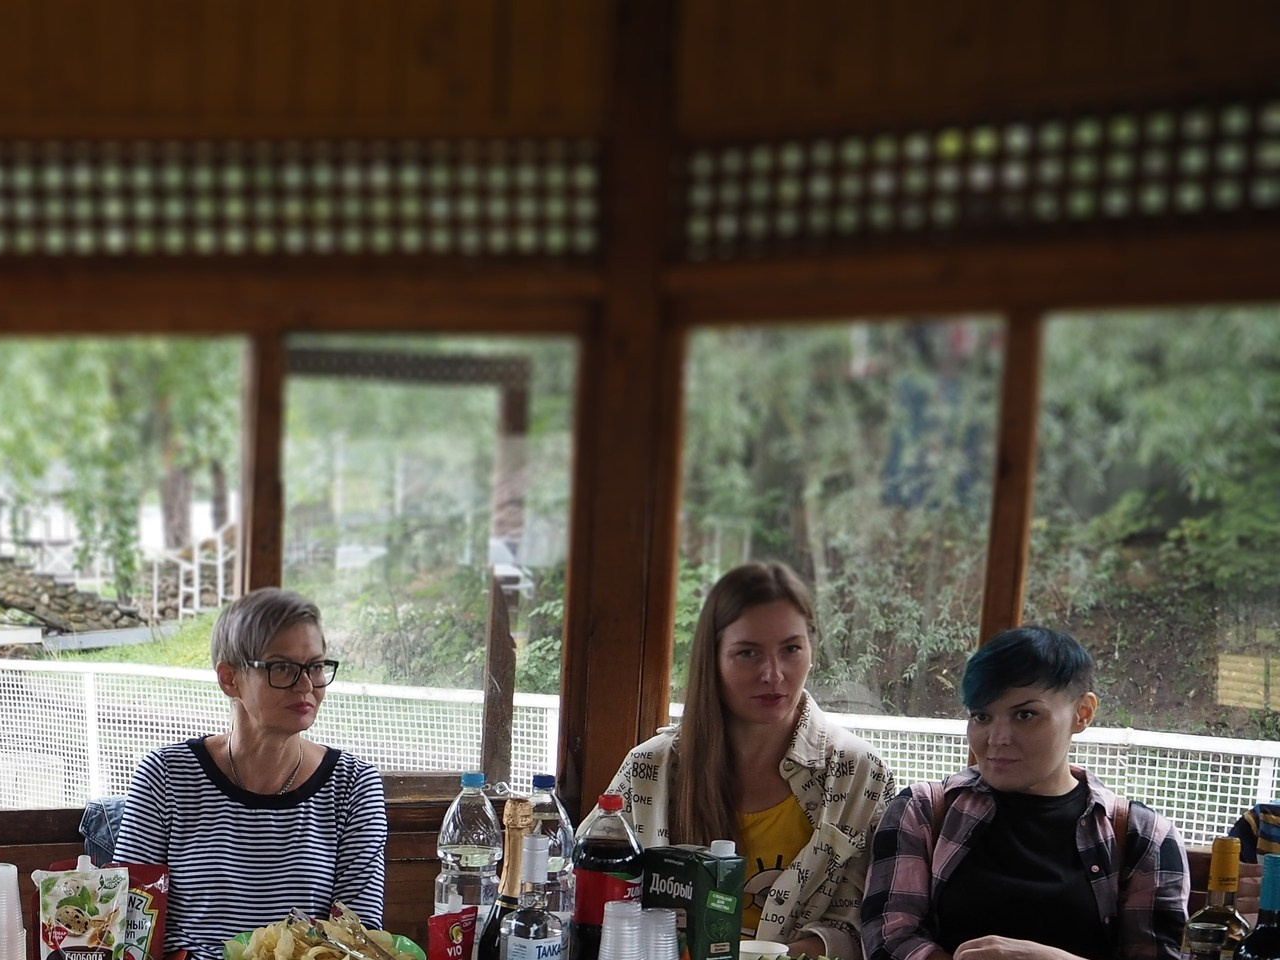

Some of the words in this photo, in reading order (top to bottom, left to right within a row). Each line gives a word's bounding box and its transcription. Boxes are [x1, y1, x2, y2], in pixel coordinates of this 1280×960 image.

[650, 872, 694, 901] Добрый
[128, 895, 144, 911] NZ
[535, 943, 562, 960] ТАЛКА
